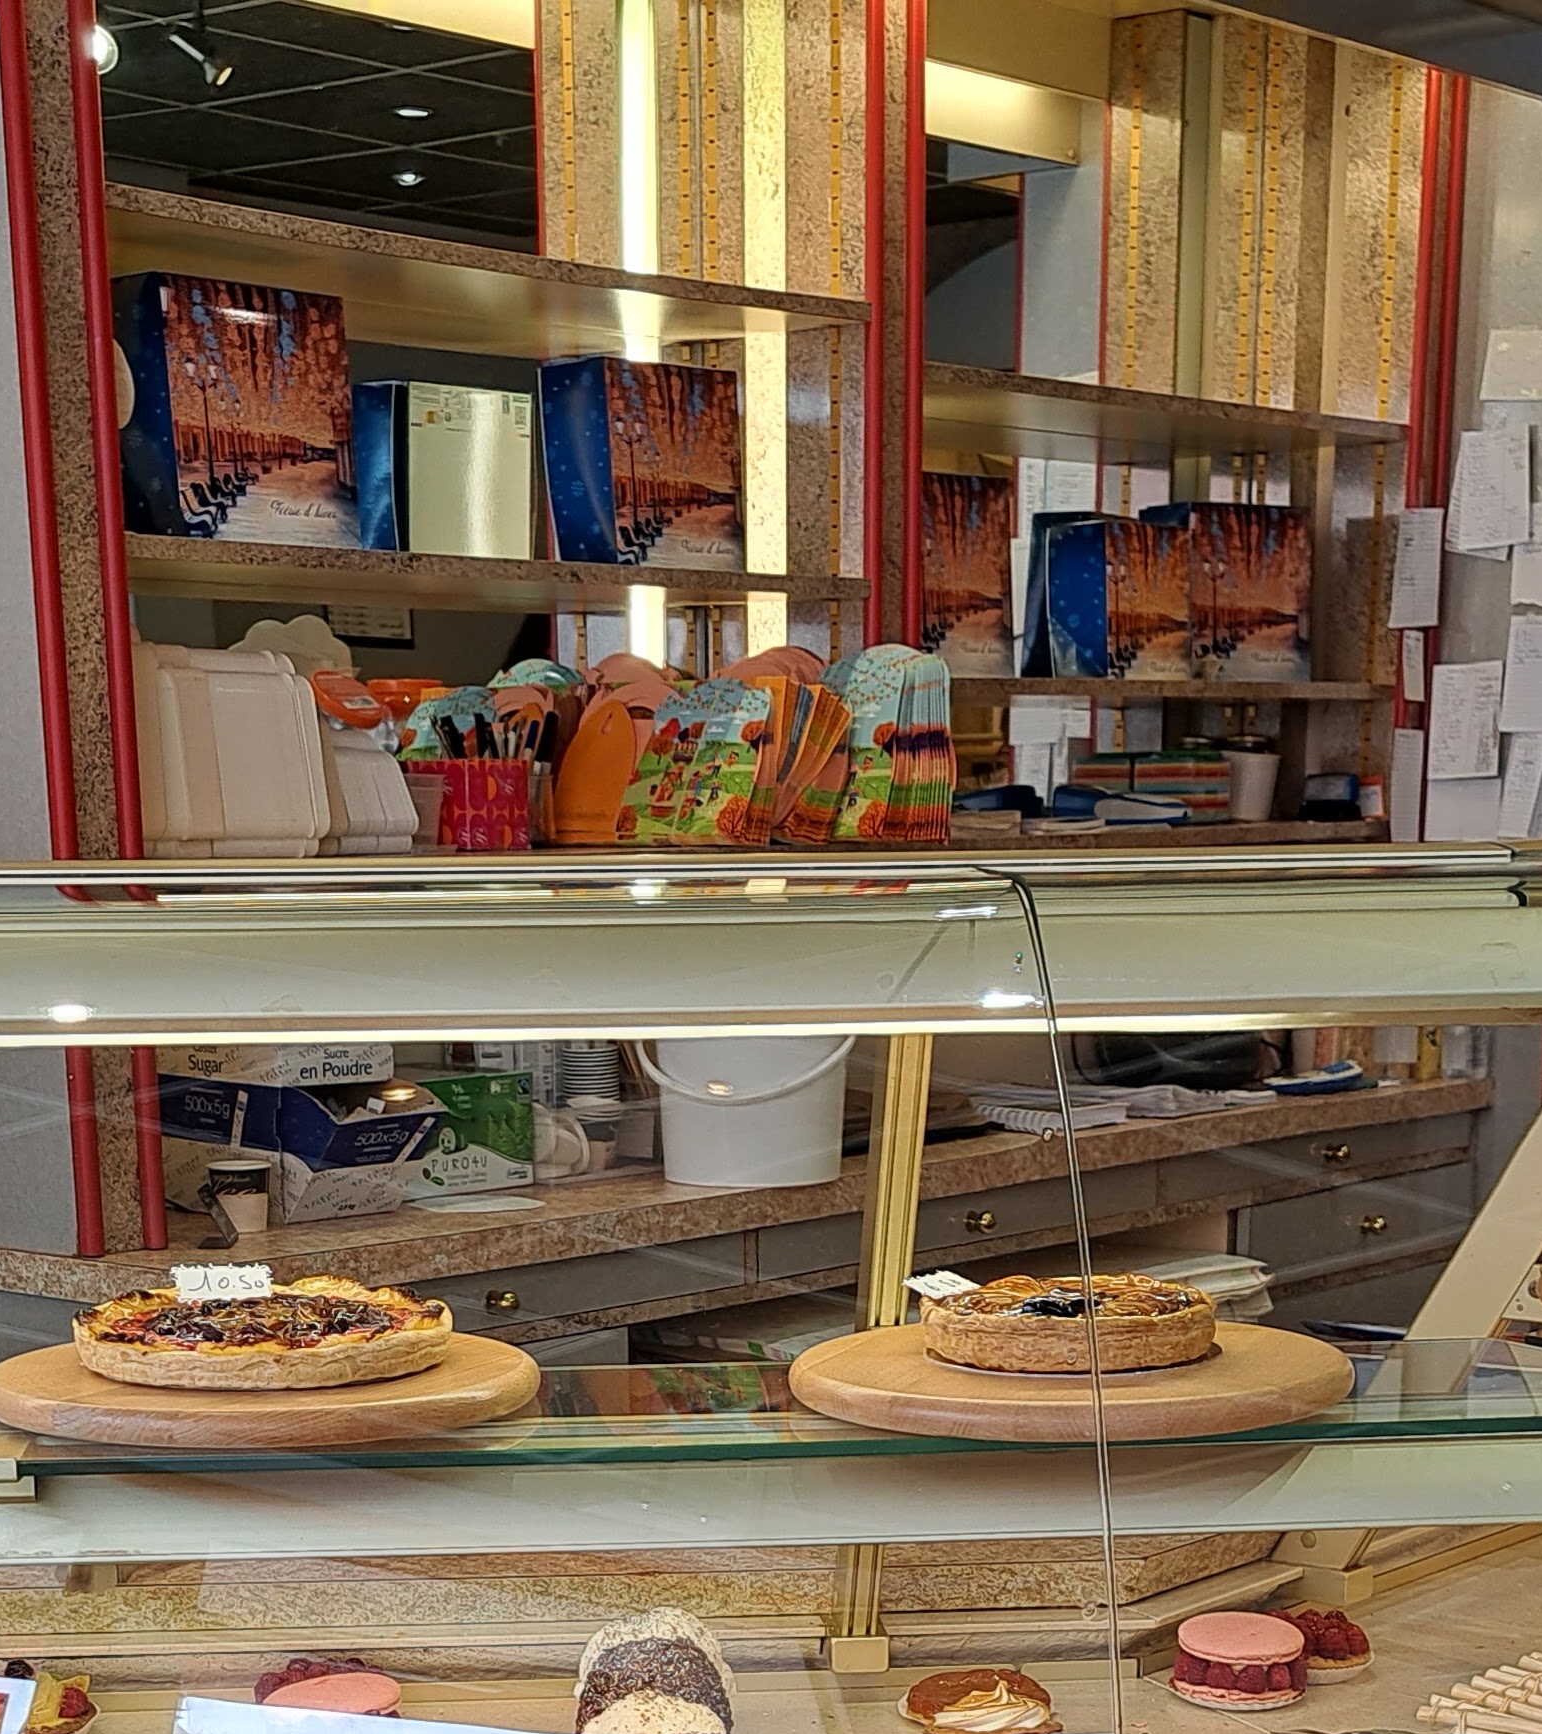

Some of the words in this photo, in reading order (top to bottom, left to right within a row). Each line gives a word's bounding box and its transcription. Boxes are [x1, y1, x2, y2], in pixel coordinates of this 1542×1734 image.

[323, 1047, 349, 1060] Sucre
[188, 1054, 225, 1078] Sugar
[299, 1066, 318, 1080] en
[322, 1060, 373, 1078] Poudre
[187, 1270, 265, 1293] 10.50
